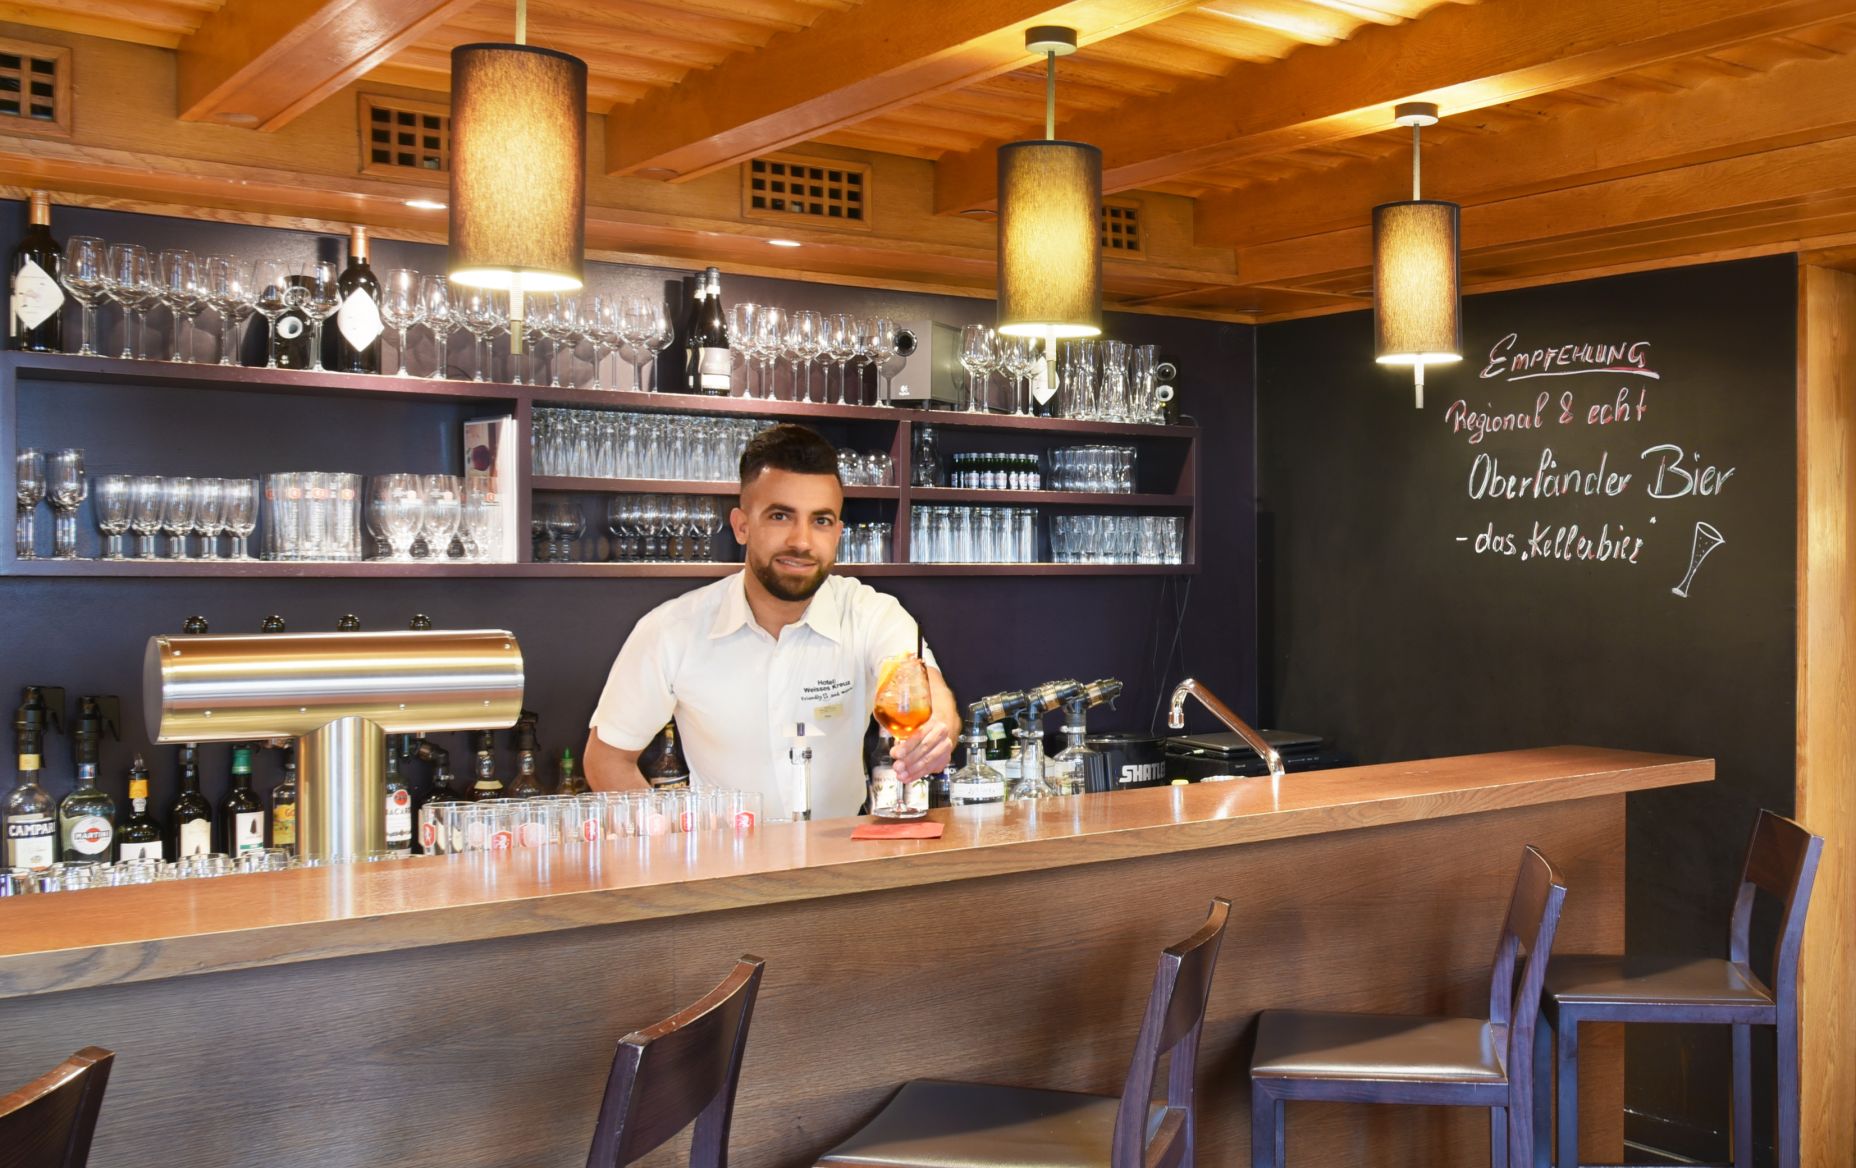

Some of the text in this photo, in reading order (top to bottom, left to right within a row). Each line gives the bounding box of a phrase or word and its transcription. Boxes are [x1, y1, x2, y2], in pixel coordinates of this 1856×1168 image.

[1445, 386, 1647, 444] Regional & echt
[1468, 444, 1736, 500] Oberländer Bier
